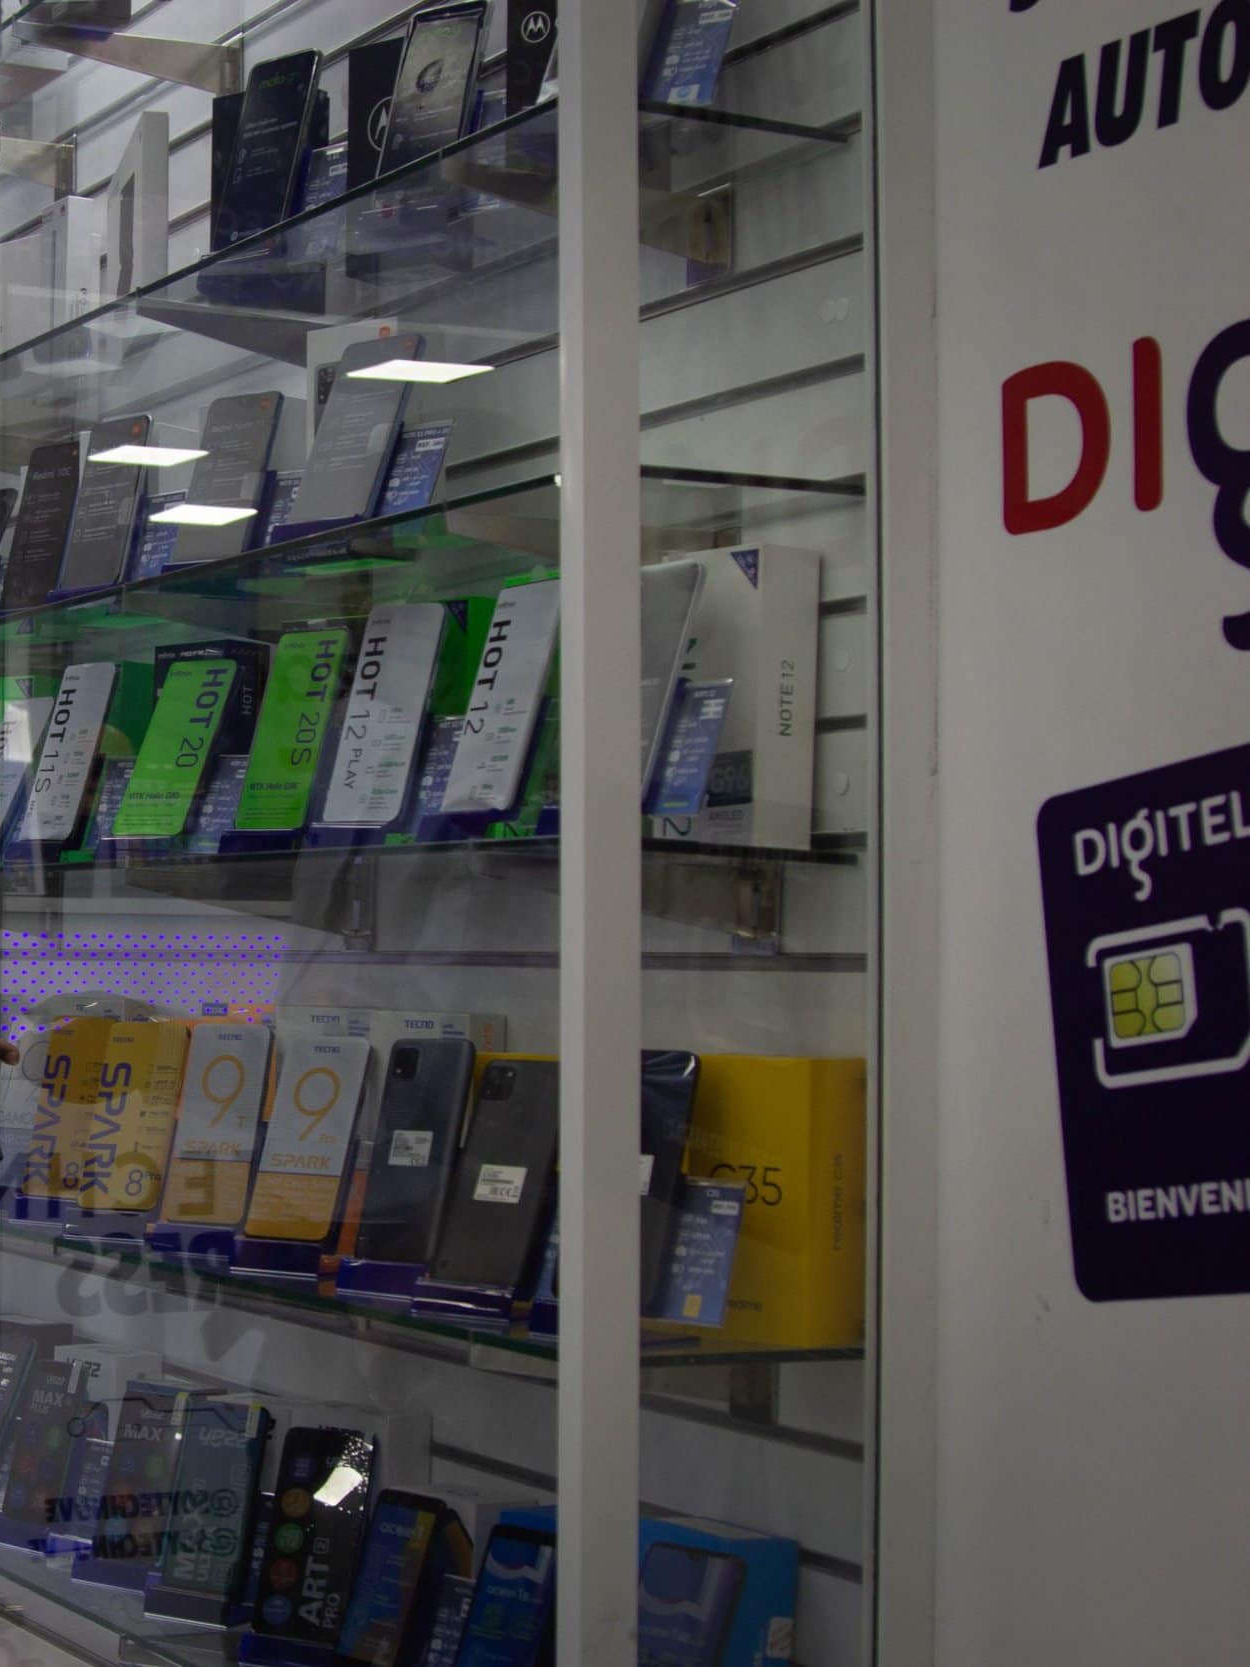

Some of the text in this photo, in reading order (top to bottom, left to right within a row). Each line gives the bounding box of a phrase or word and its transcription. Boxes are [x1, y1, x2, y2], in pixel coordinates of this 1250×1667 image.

[1038, 0, 1250, 169] AUTO
[189, 668, 229, 728] HOT
[290, 638, 338, 766] HOT 20S
[343, 636, 387, 789] HOT 12 PLAY
[463, 619, 511, 736] HOT 12
[778, 660, 795, 737] NOTE 12
[49, 688, 77, 743] HOT
[175, 737, 205, 768] 20
[34, 751, 60, 793] 11S
[1073, 790, 1250, 902] DIGITEL
[23, 1054, 72, 1186] SPARK
[79, 1061, 132, 1195] SPARK
[202, 1054, 245, 1129] 9
[293, 1066, 341, 1142] 9
[125, 1169, 143, 1196] 8
[270, 1152, 331, 1170] SPARK
[124, 1423, 163, 1441] MAX
[298, 1556, 330, 1627] ART
[324, 1593, 342, 1629] PRO
